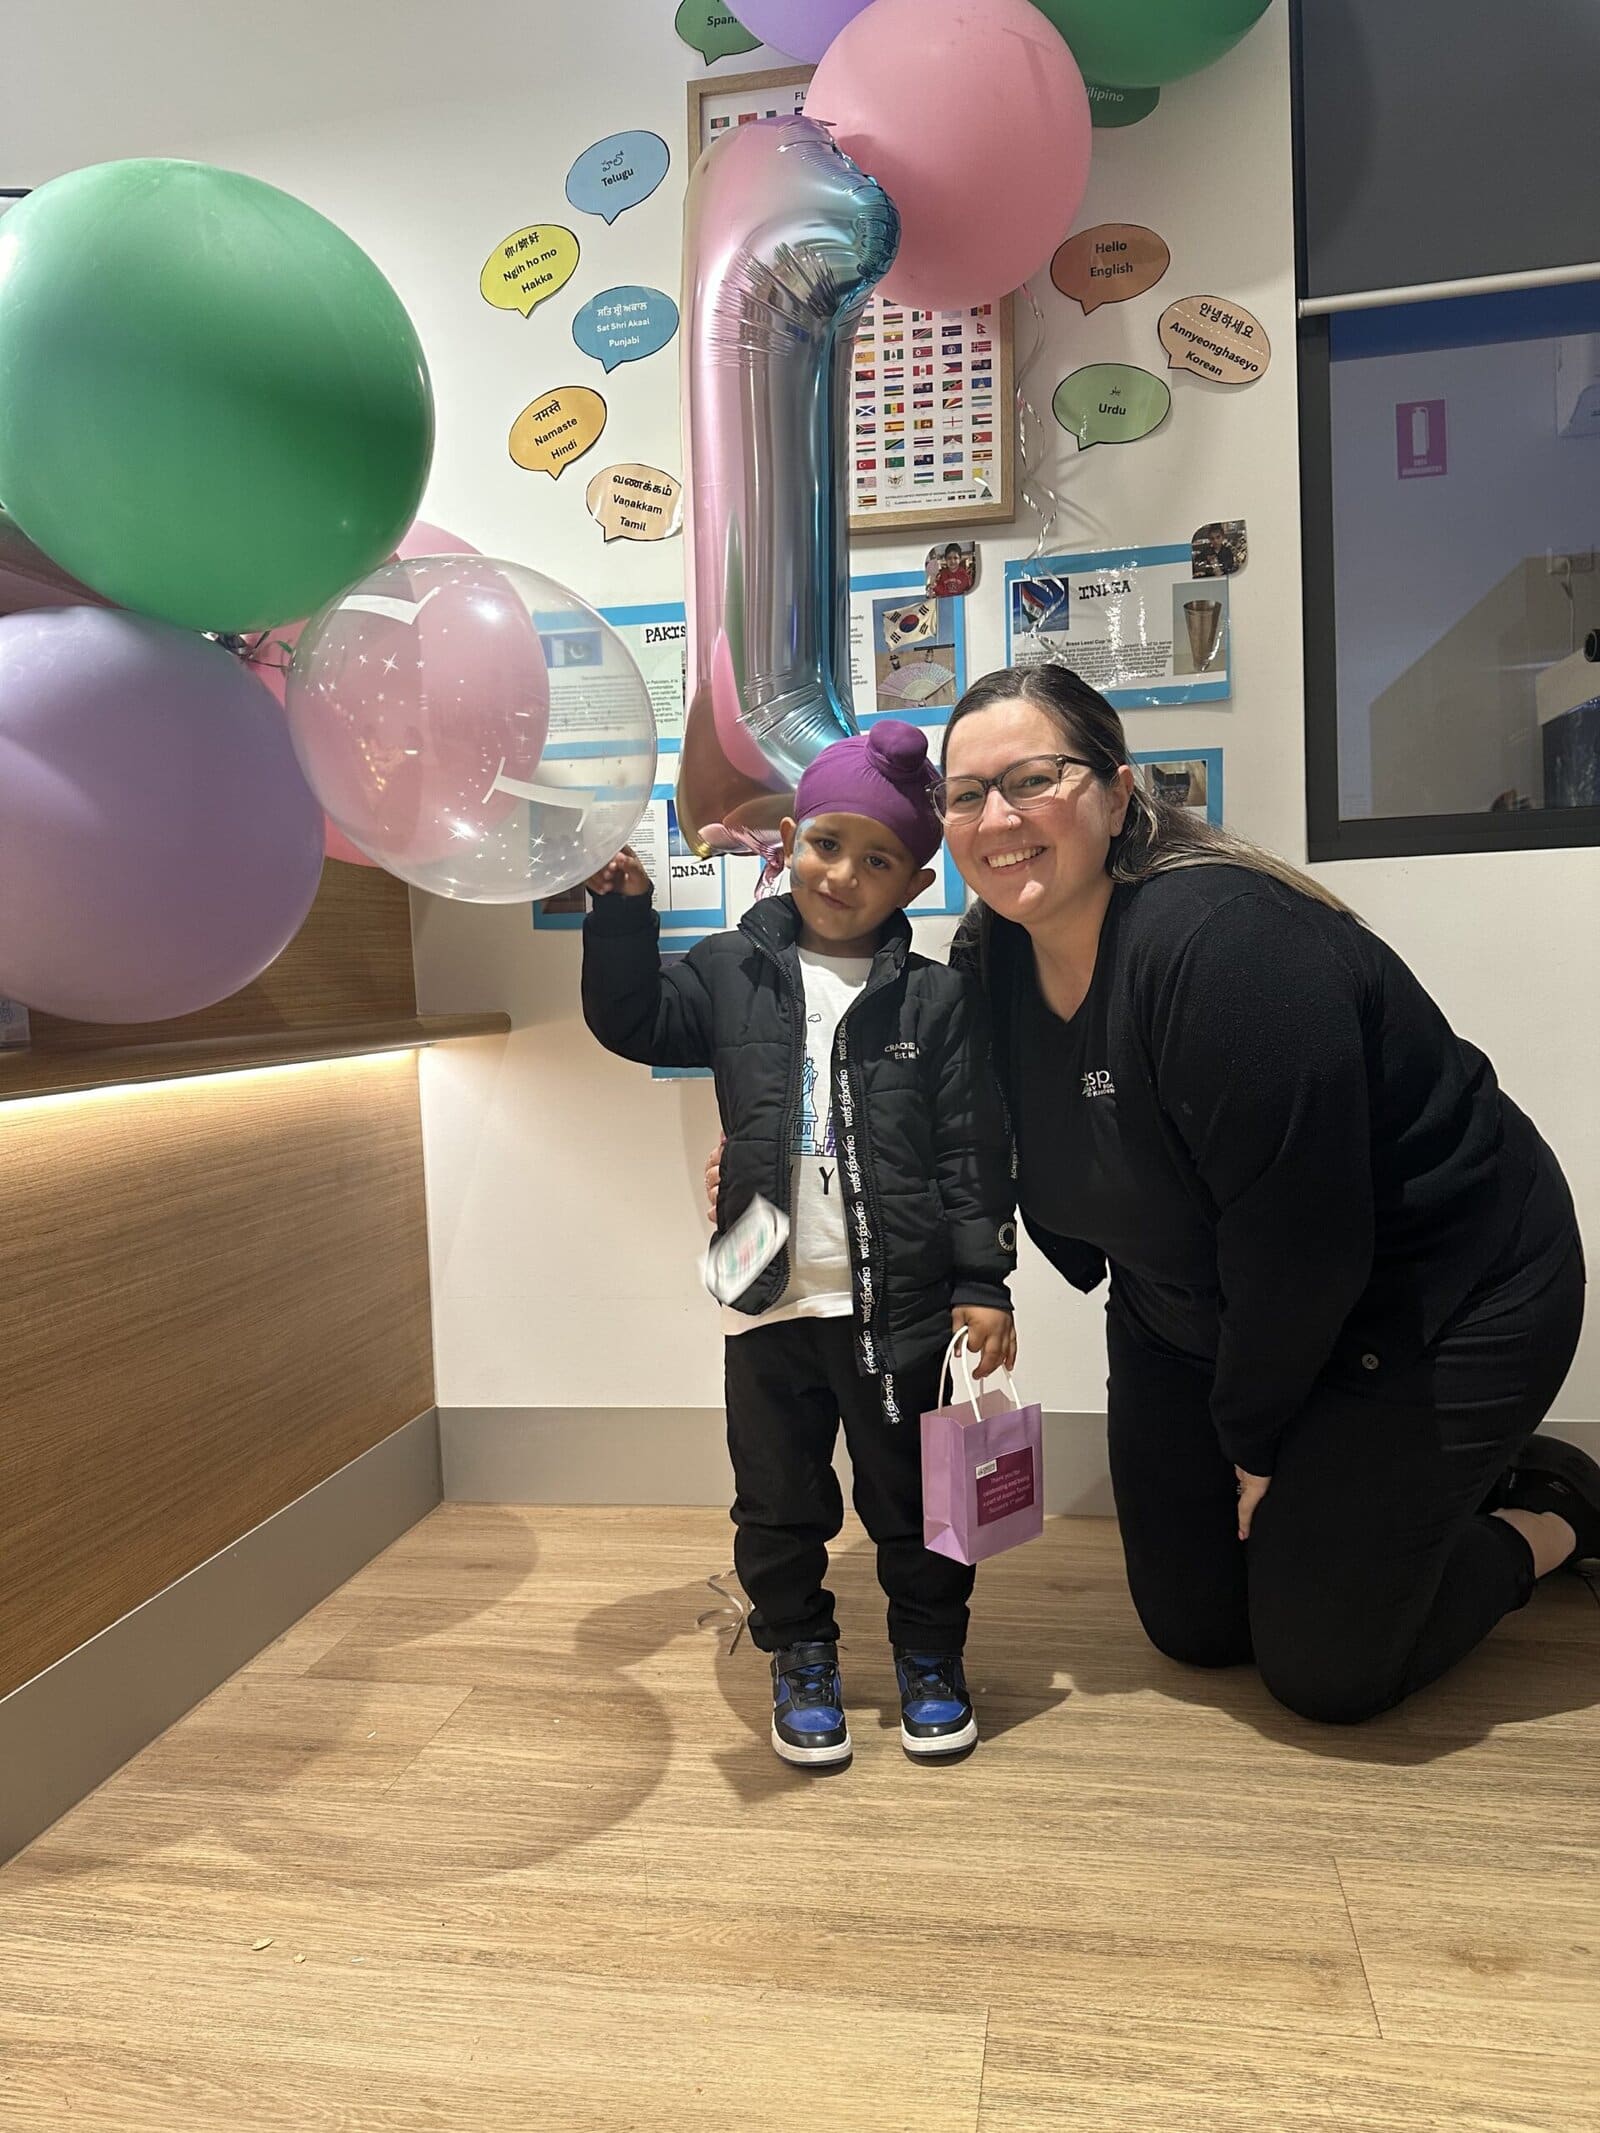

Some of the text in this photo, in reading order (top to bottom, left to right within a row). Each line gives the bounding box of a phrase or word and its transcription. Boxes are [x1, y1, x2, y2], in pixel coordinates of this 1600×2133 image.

[794, 91, 806, 100] FL
[1087, 86, 1124, 101] ilipino
[601, 168, 634, 187] Telugu
[1095, 241, 1127, 254] Hello
[503, 248, 558, 282] Ngih ho mo
[1090, 263, 1133, 278] English
[521, 272, 553, 293] Hakka
[596, 318, 650, 333] Sat Shri Akaal
[1199, 303, 1254, 339] 안녕하세요
[609, 336, 640, 347] Punjabi
[1170, 322, 1259, 373] Annyeonghaseyo
[1185, 351, 1223, 376] Korean
[532, 399, 561, 422] नमस्ते
[1098, 403, 1126, 415] Urdu
[534, 418, 578, 446] Namaste
[550, 439, 578, 459] Hindi
[612, 475, 672, 497] வணக்கம்
[620, 516, 646, 532] Tamil
[645, 626, 686, 643] PAKIS
[672, 864, 715, 878] INDIA
[836, 1069, 853, 1105] CRACKED
[842, 1135, 861, 1173] CRACKED
[851, 1201, 870, 1237] CRACKED
[858, 1266, 873, 1303] CRACKED
